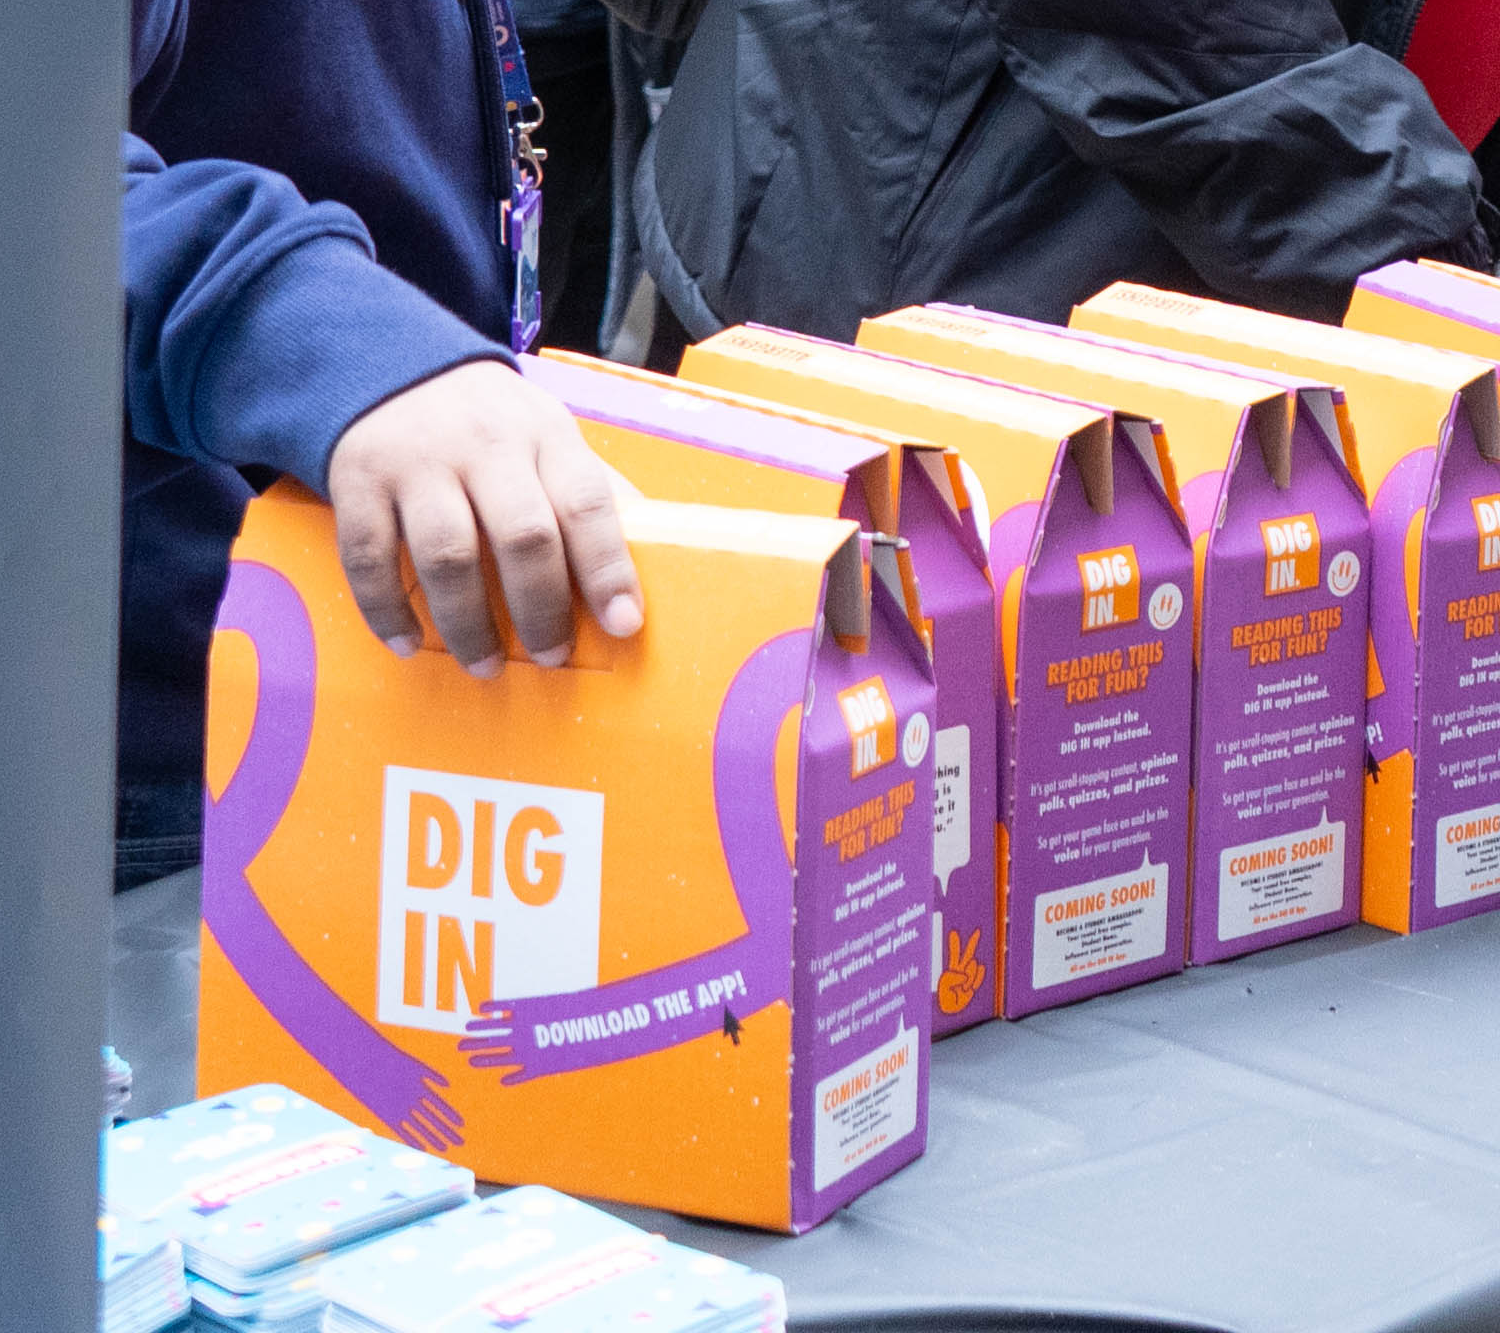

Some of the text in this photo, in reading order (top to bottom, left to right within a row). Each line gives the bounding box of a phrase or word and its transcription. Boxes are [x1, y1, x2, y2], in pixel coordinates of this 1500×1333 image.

[1267, 521, 1312, 556] DIG
[1085, 553, 1131, 591] DIG
[1271, 558, 1300, 591] IN.
[1088, 593, 1119, 627] IN.
[1232, 607, 1342, 647] READING THIS
[1465, 615, 1494, 639] FOR
[1047, 641, 1164, 684] READING THIS
[1251, 630, 1328, 665] FOR FUN?
[1067, 665, 1149, 702] FOR FUN?
[1257, 672, 1318, 696] Download the
[1459, 673, 1475, 688] DIG
[1477, 671, 1487, 683] IN
[843, 686, 887, 732] DIG
[1244, 685, 1329, 715] DIG IN app instead.
[1074, 708, 1139, 733] Download the
[1320, 713, 1354, 734] opinion
[856, 729, 882, 772] IN.
[1060, 723, 1151, 754] DIG IN app instead.
[1251, 744, 1290, 767] quizzes,
[1293, 739, 1311, 755] and
[1314, 731, 1346, 752] prizes.
[1141, 750, 1178, 774] opinion
[943, 785, 951, 795] is
[1069, 785, 1110, 808] quizzes,
[1114, 778, 1132, 794] and
[1135, 771, 1169, 793] prizes.
[1453, 773, 1477, 790] voice
[824, 779, 915, 843] READING THIS
[1237, 802, 1262, 820] voice
[839, 810, 904, 862] FOR FUN?
[1446, 816, 1500, 843] COMING
[407, 791, 565, 906] DIG
[1054, 846, 1080, 863] voice
[1230, 834, 1333, 876] COMING SOON!
[1045, 879, 1156, 923] COMING SOON!
[403, 910, 495, 1017] IN
[534, 970, 747, 1049] DOWNLOAD THE APP!
[823, 1045, 909, 1113] COMING SOON!
